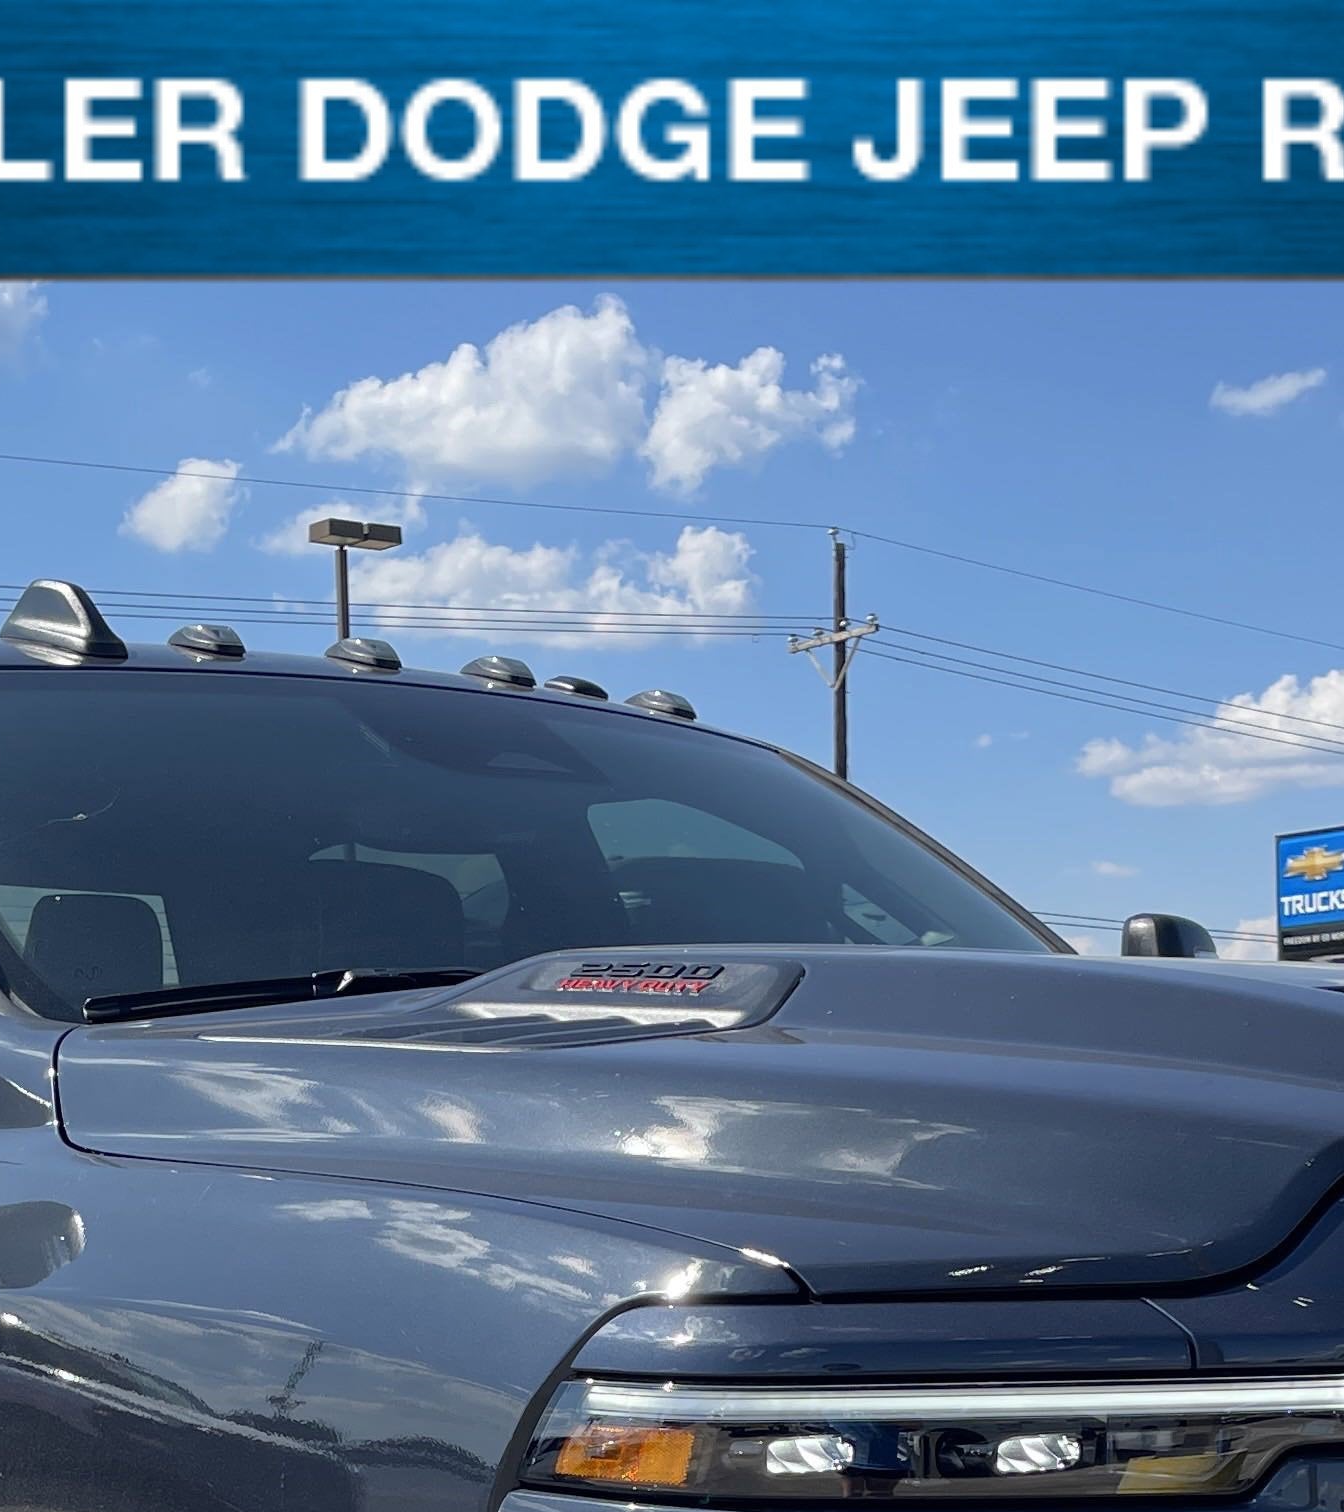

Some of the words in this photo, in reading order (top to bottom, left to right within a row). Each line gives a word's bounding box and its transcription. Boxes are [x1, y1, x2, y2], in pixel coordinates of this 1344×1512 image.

[570, 962, 724, 980] 2500
[557, 979, 634, 992] HEAVY
[638, 980, 712, 995] DUTY
